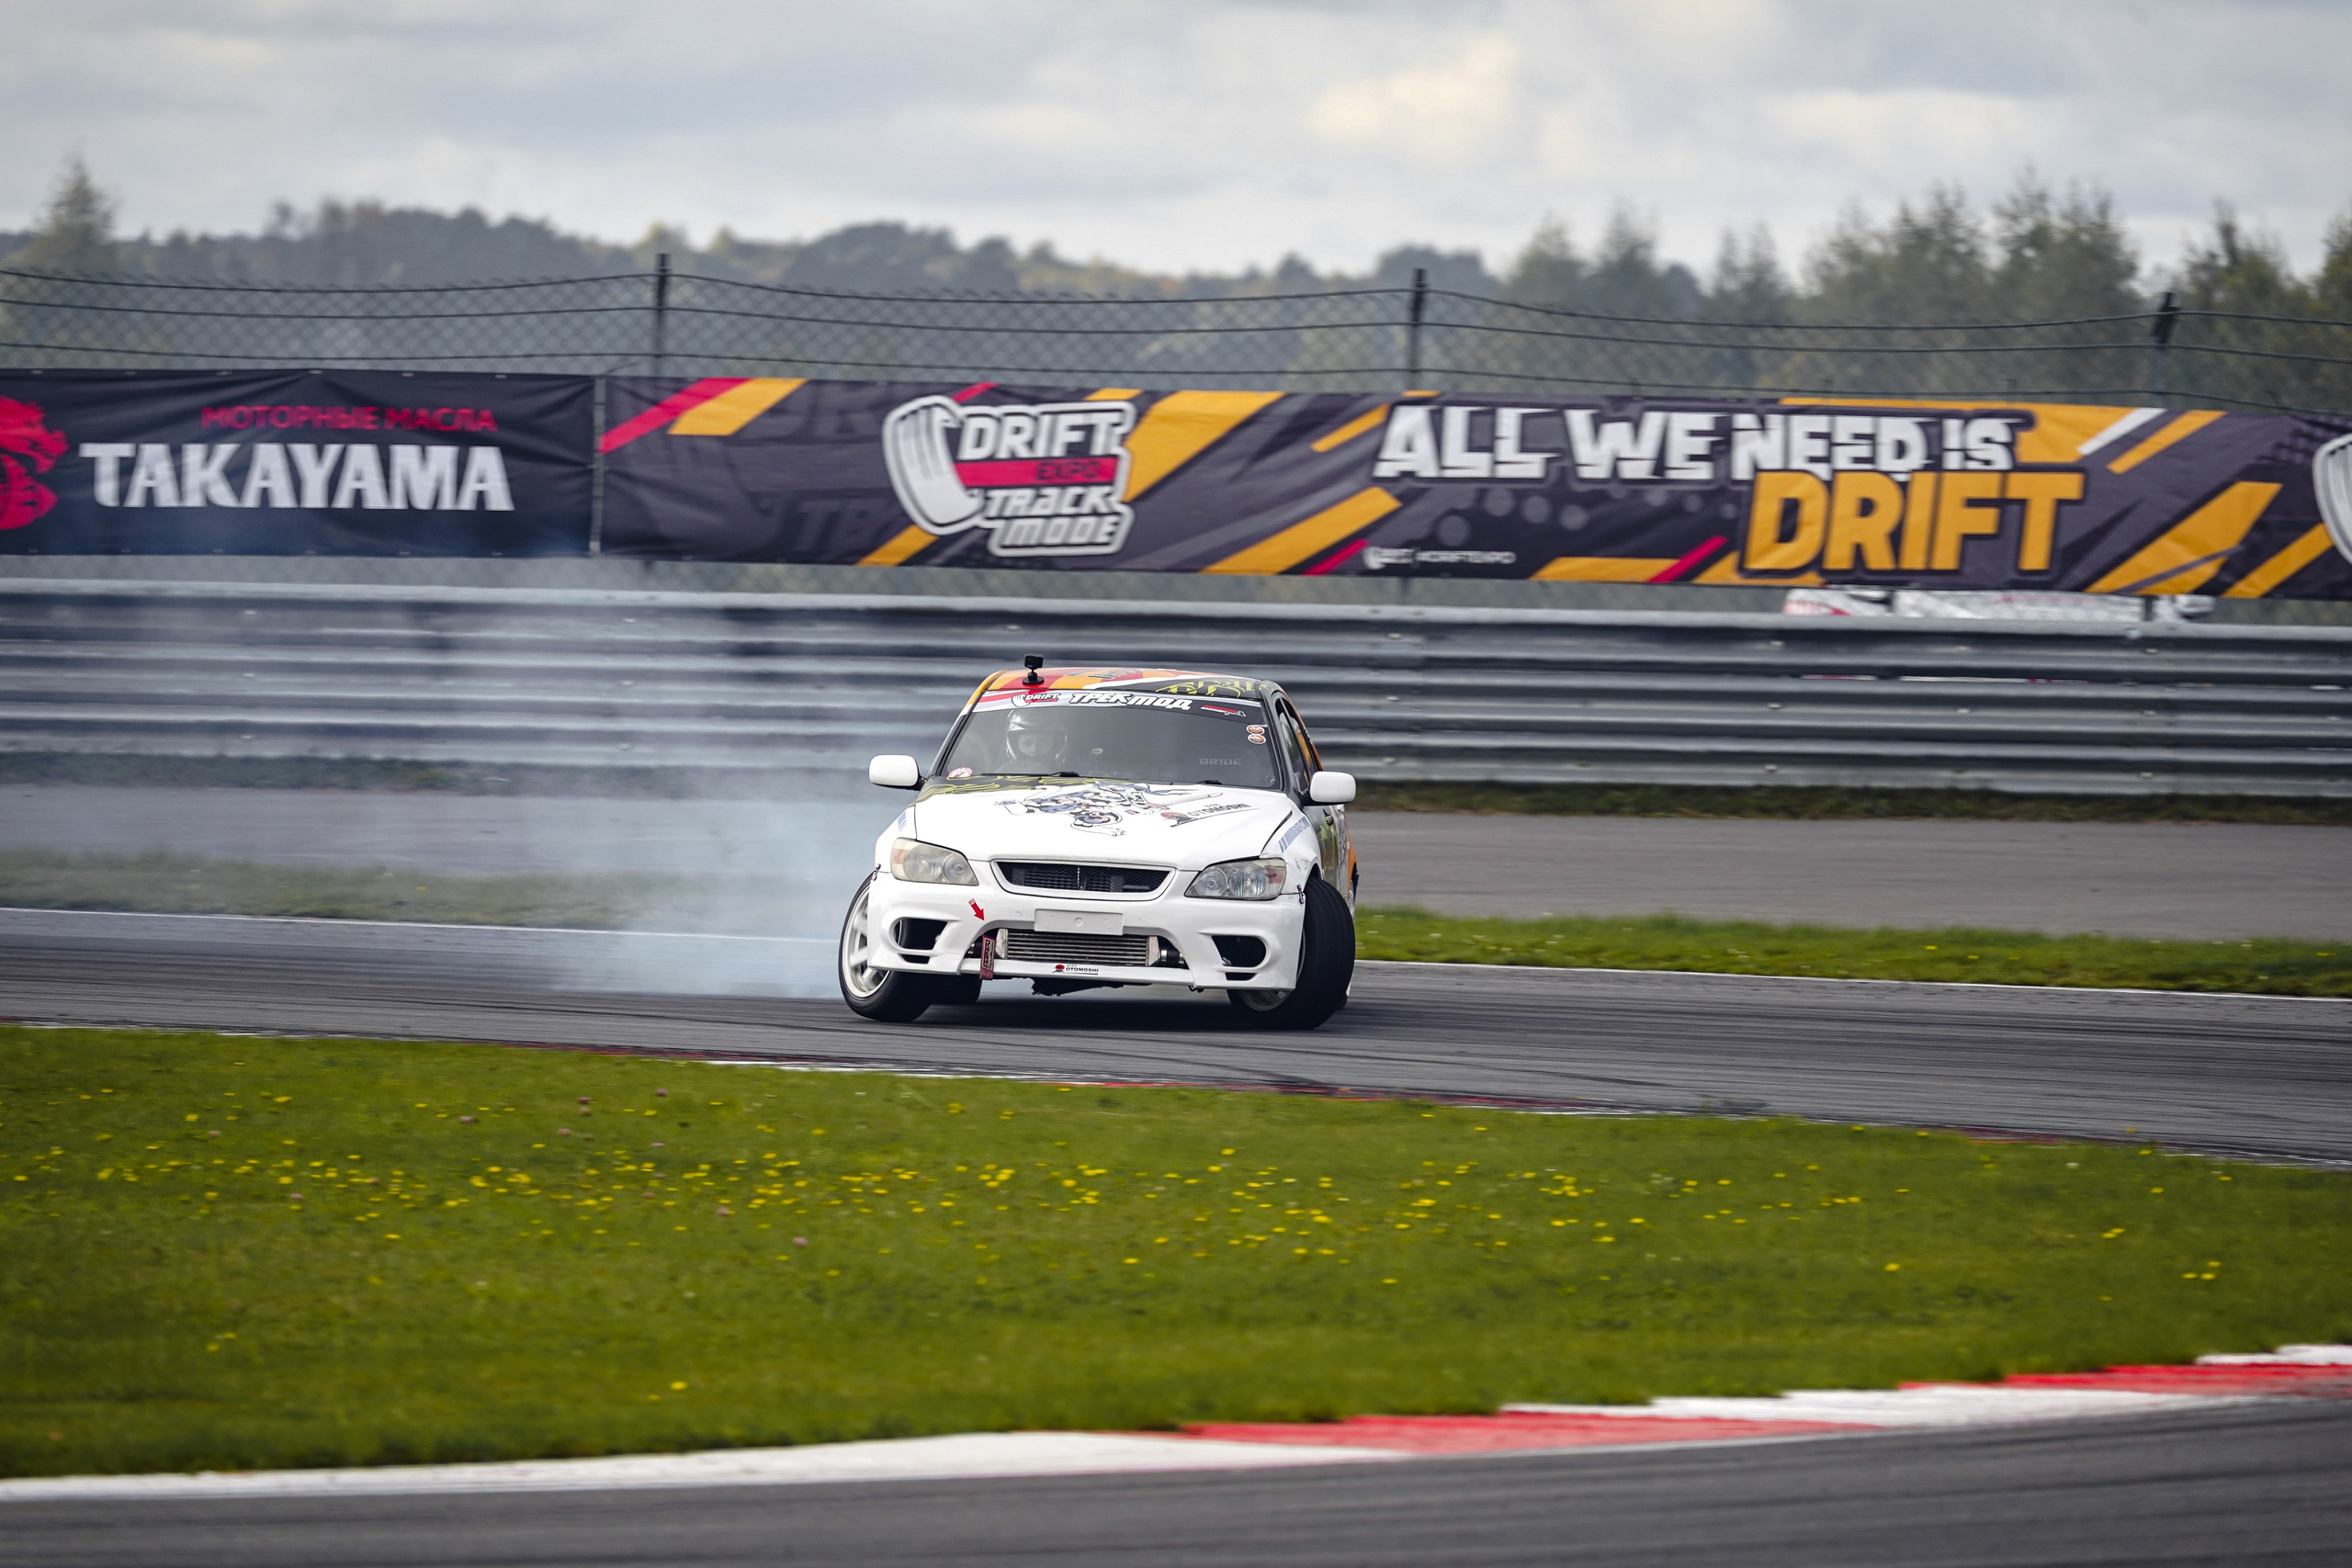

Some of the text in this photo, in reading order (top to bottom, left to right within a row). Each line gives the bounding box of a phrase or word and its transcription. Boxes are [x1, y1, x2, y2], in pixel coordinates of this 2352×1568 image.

[199, 405, 498, 432] МОТОРНЫЕ МАСЛА
[957, 412, 1124, 459] DRIFT
[1373, 404, 2024, 481] ALL WE NEED IS
[80, 442, 514, 511] TAKAYAMA
[1743, 470, 2086, 570] DRIFT
[1024, 693, 1062, 702] DRIFT
